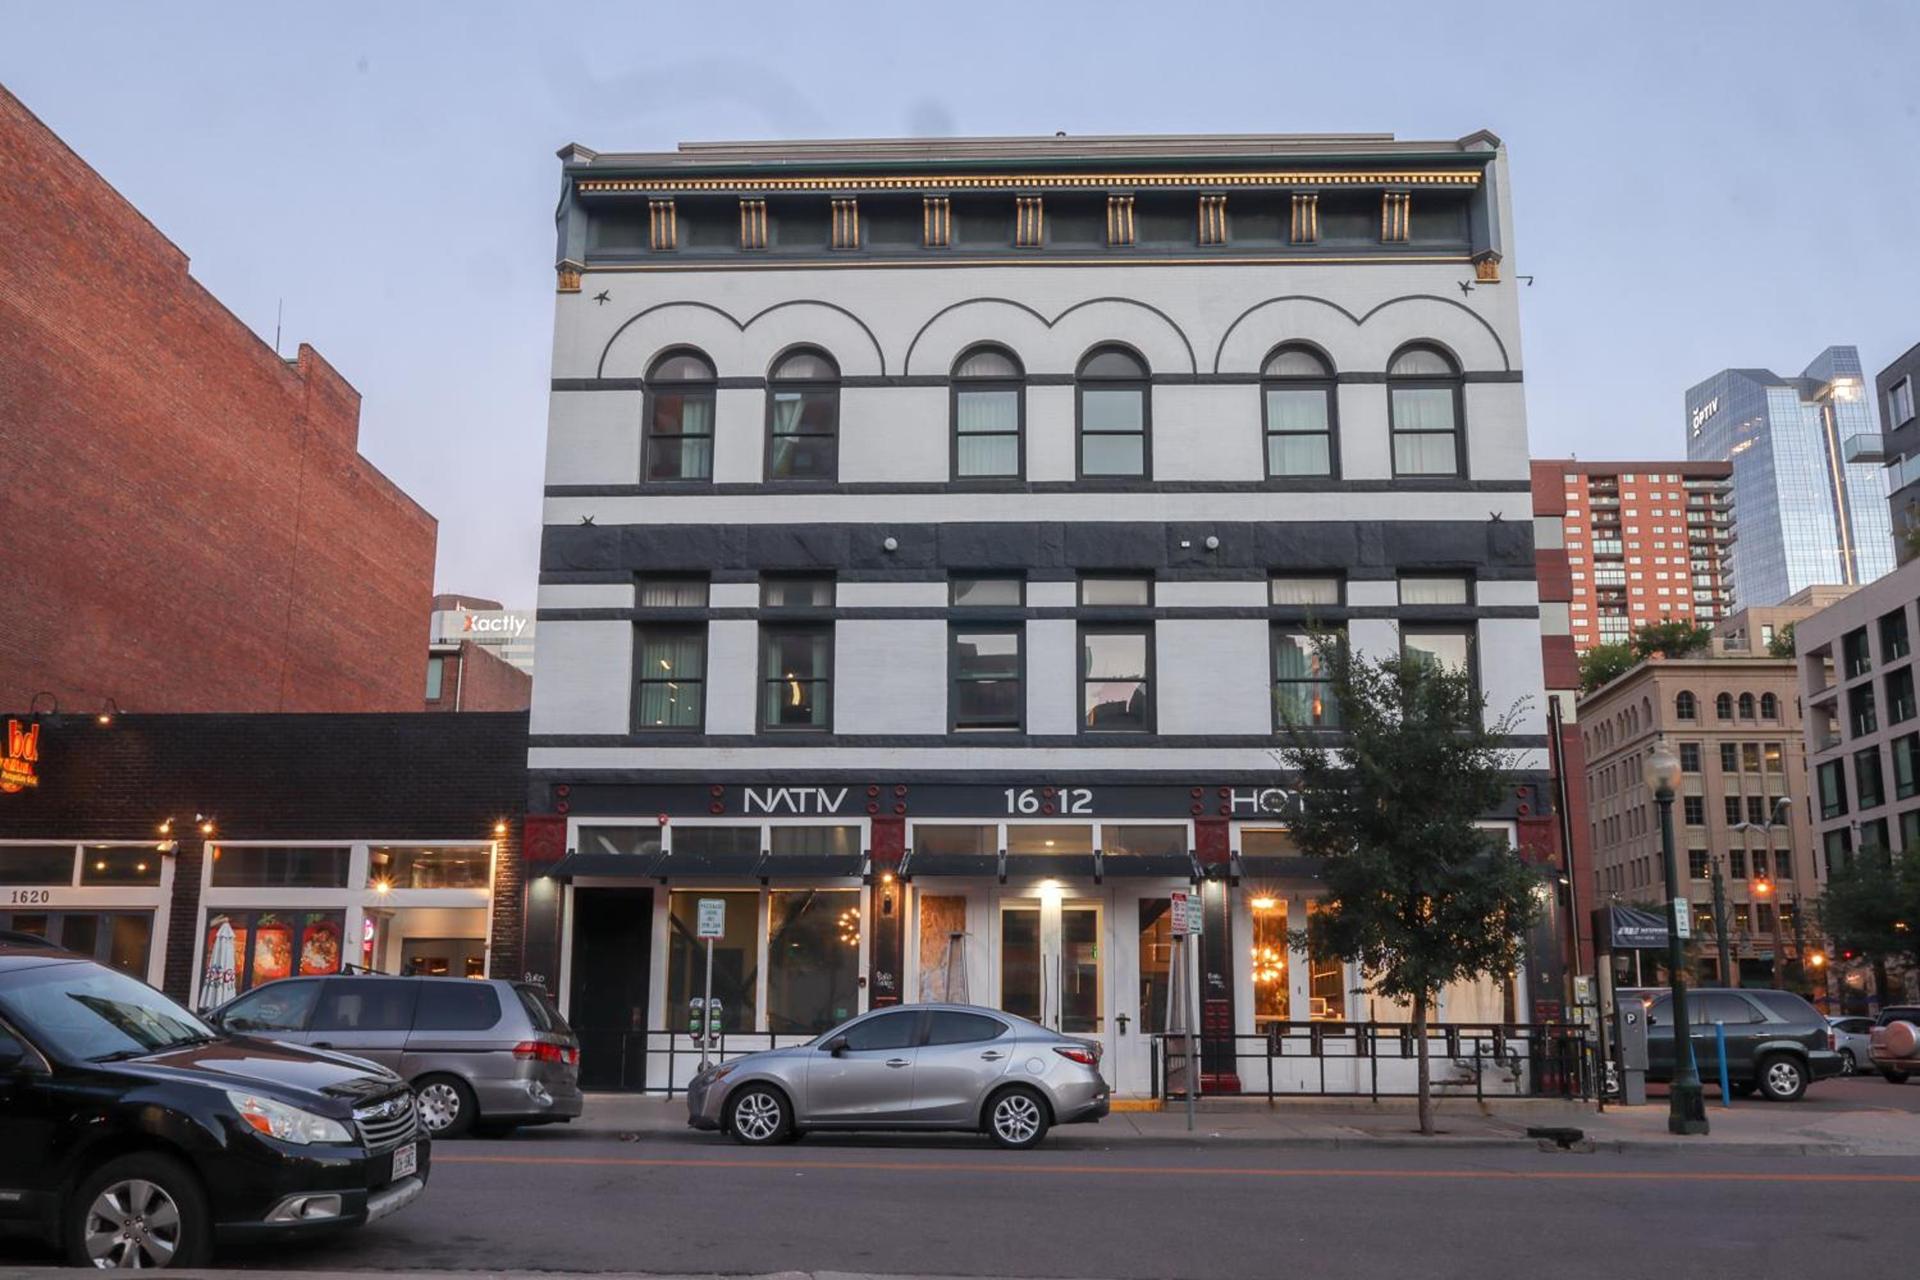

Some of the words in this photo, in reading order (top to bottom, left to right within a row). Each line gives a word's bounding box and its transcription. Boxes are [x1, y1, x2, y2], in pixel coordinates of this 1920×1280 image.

[1693, 397, 1718, 430] OPTIV
[463, 614, 526, 637] Xactly
[744, 787, 848, 813] NATIV
[11, 890, 50, 904] 1620
